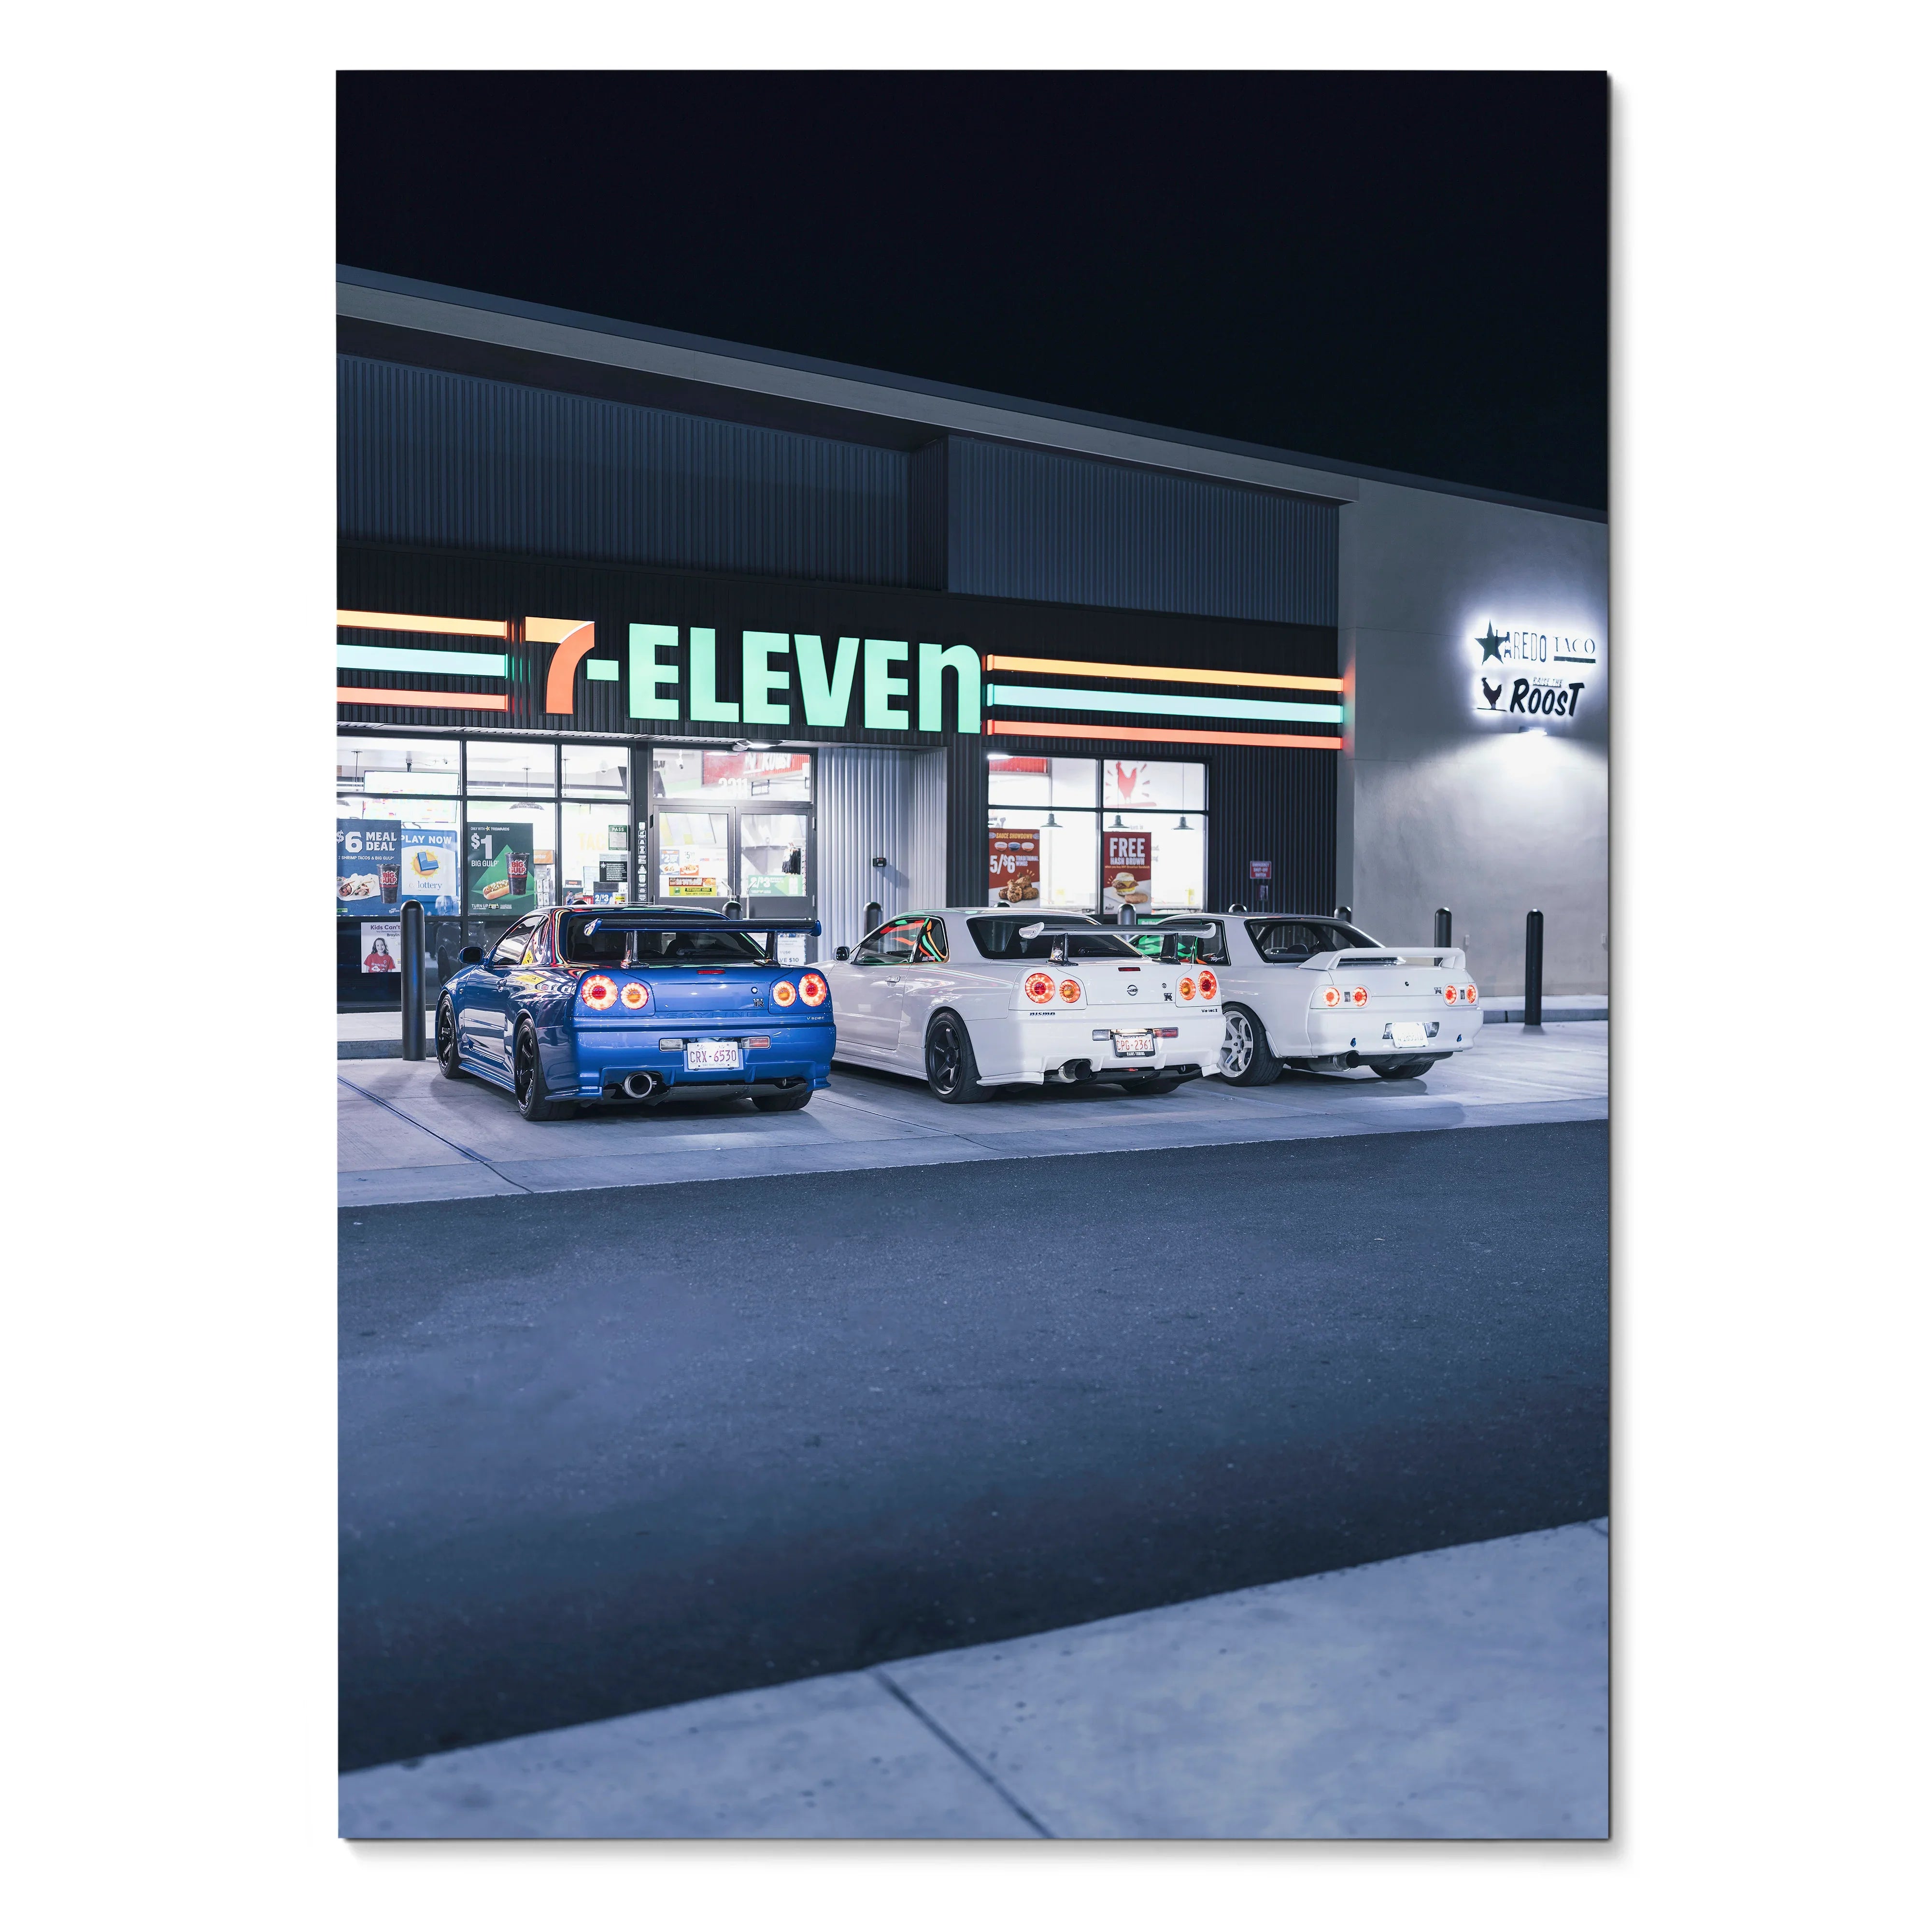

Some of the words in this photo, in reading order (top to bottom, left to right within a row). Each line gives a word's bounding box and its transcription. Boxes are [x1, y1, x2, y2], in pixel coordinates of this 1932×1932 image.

[1553, 636, 1596, 654] TACO
[366, 832, 398, 842] MEAL
[428, 836, 452, 844] NOW
[366, 842, 395, 852] DEAL
[471, 833, 492, 859] $1
[1109, 837, 1145, 858] FREE
[990, 854, 1016, 875] 5/$6
[1110, 857, 1125, 865] HASH
[1125, 857, 1145, 865] BROWN
[595, 894, 609, 903] 2/$3
[1116, 1039, 1153, 1051] CPG-2361
[690, 1050, 737, 1063] CRX-6530
